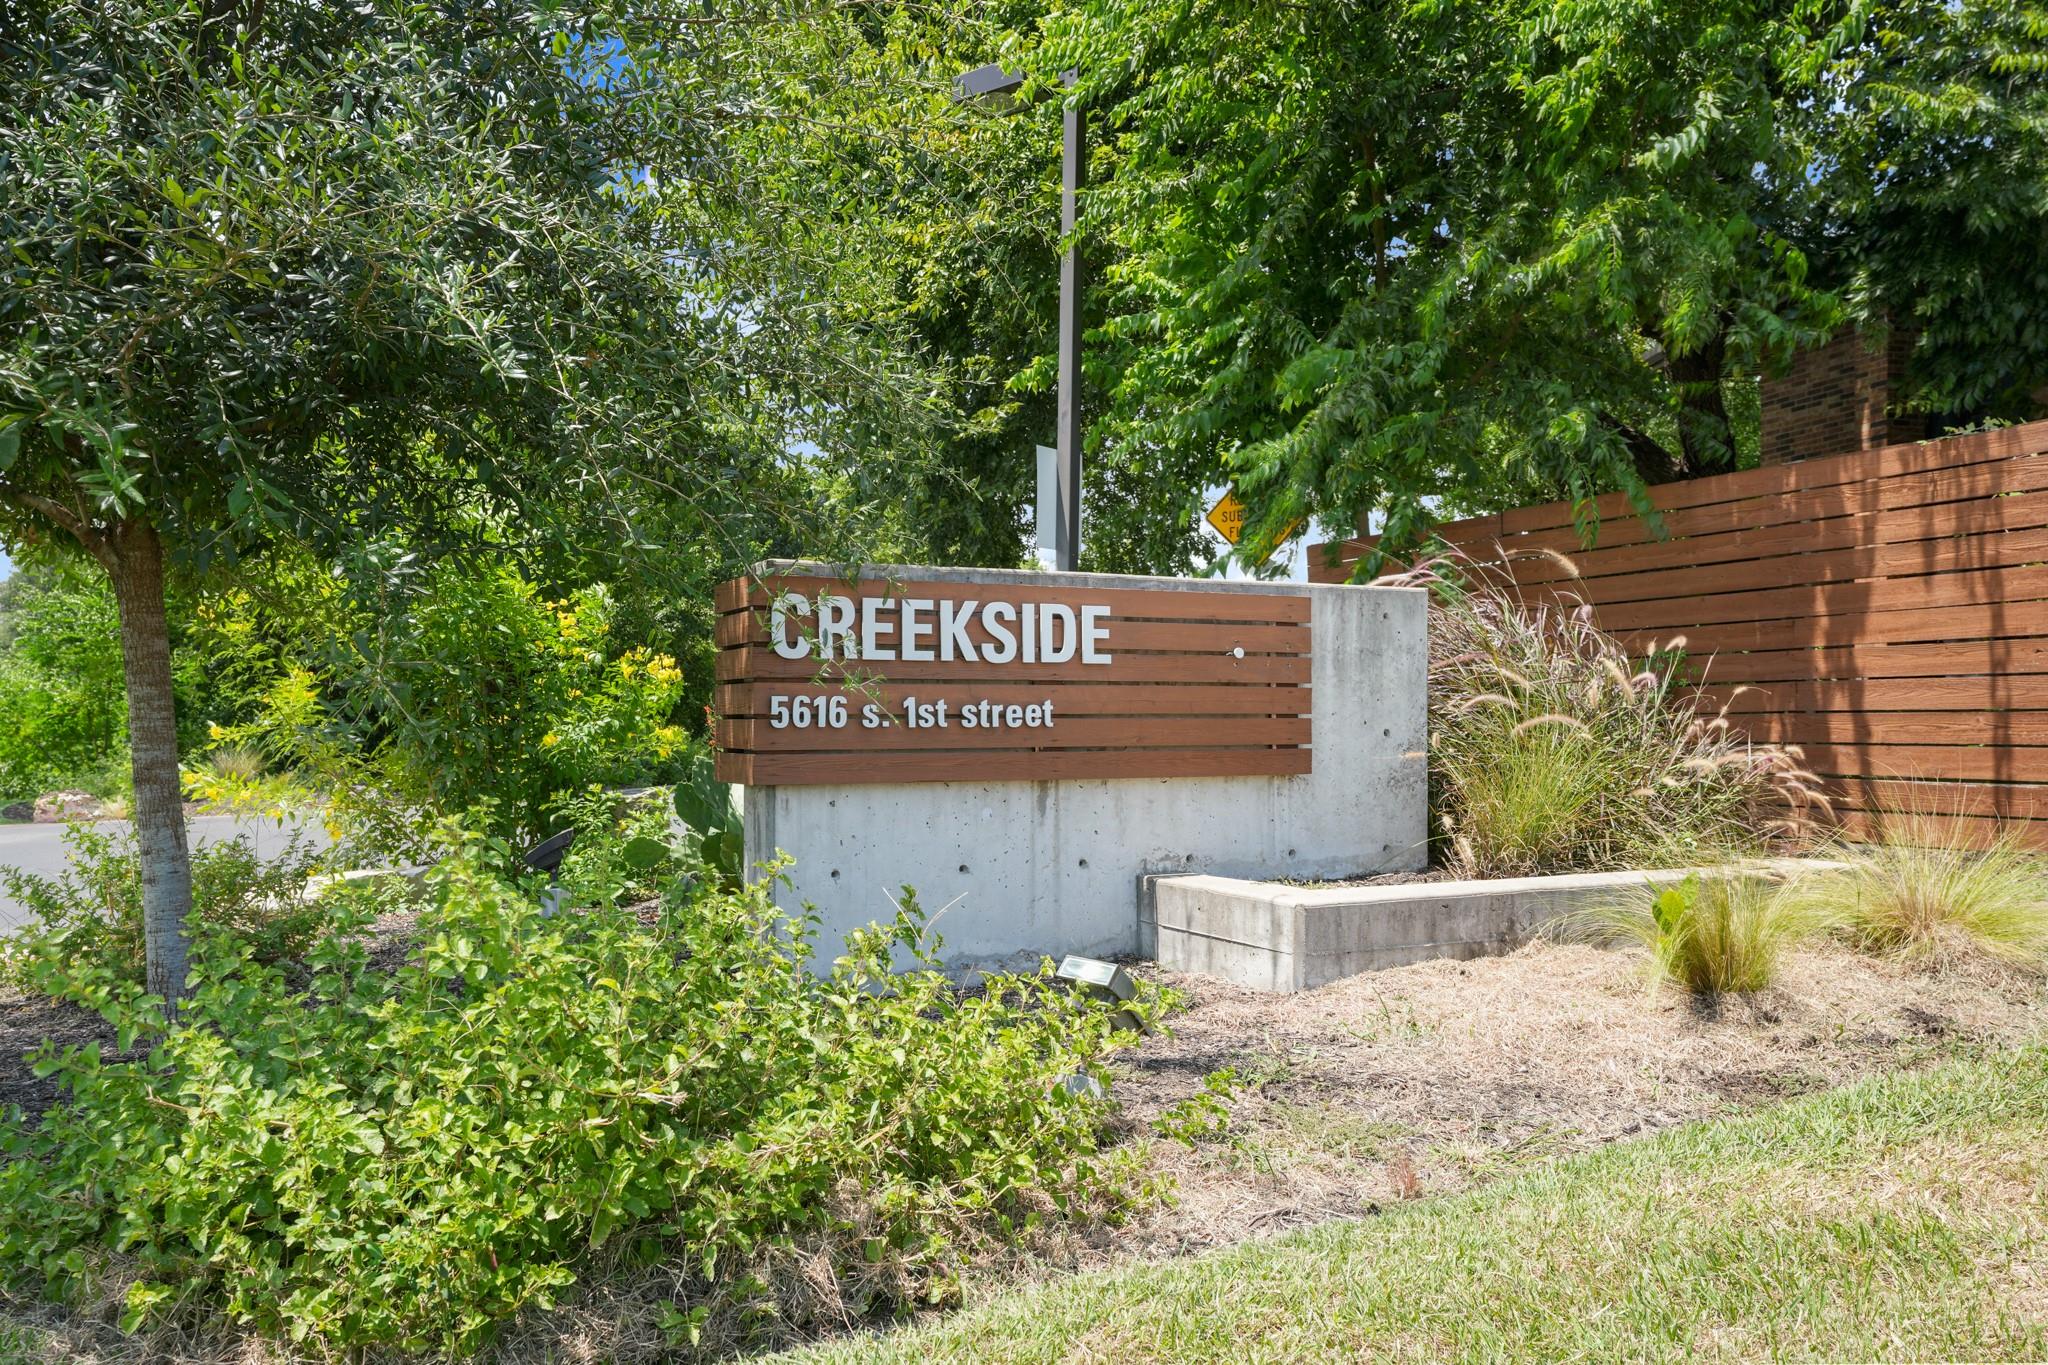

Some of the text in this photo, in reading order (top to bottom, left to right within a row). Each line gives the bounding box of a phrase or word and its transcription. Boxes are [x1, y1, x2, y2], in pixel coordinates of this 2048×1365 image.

[771, 592, 1112, 665] CREEKSIDE
[770, 695, 1054, 729] 5616 s. 1st street
